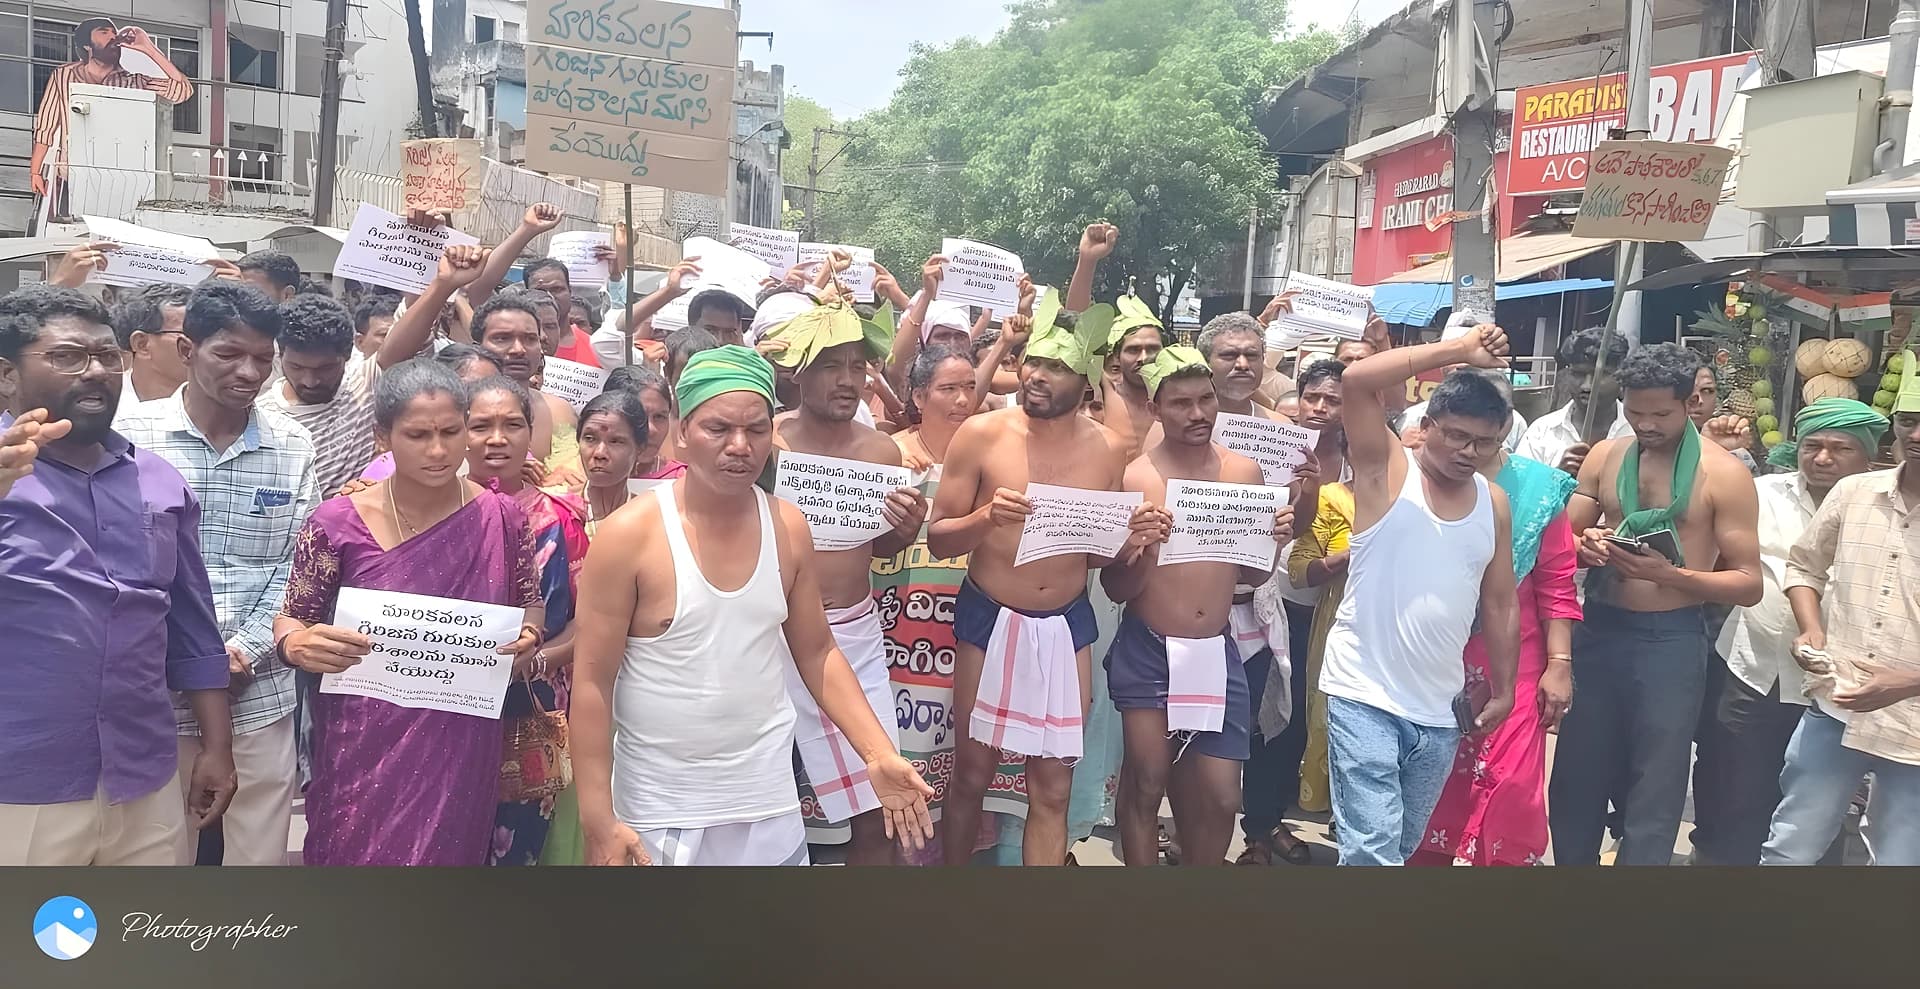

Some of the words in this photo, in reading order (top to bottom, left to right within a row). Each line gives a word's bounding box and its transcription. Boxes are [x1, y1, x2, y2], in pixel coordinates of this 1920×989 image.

[1524, 83, 1626, 122] PARADIS
[1541, 157, 1587, 183] A/C
[1382, 199, 1424, 230] IRANI
[801, 509, 836, 526] ర్పాటు
[423, 631, 497, 650] గురుకుల
[370, 642, 445, 663] ఠశాలను
